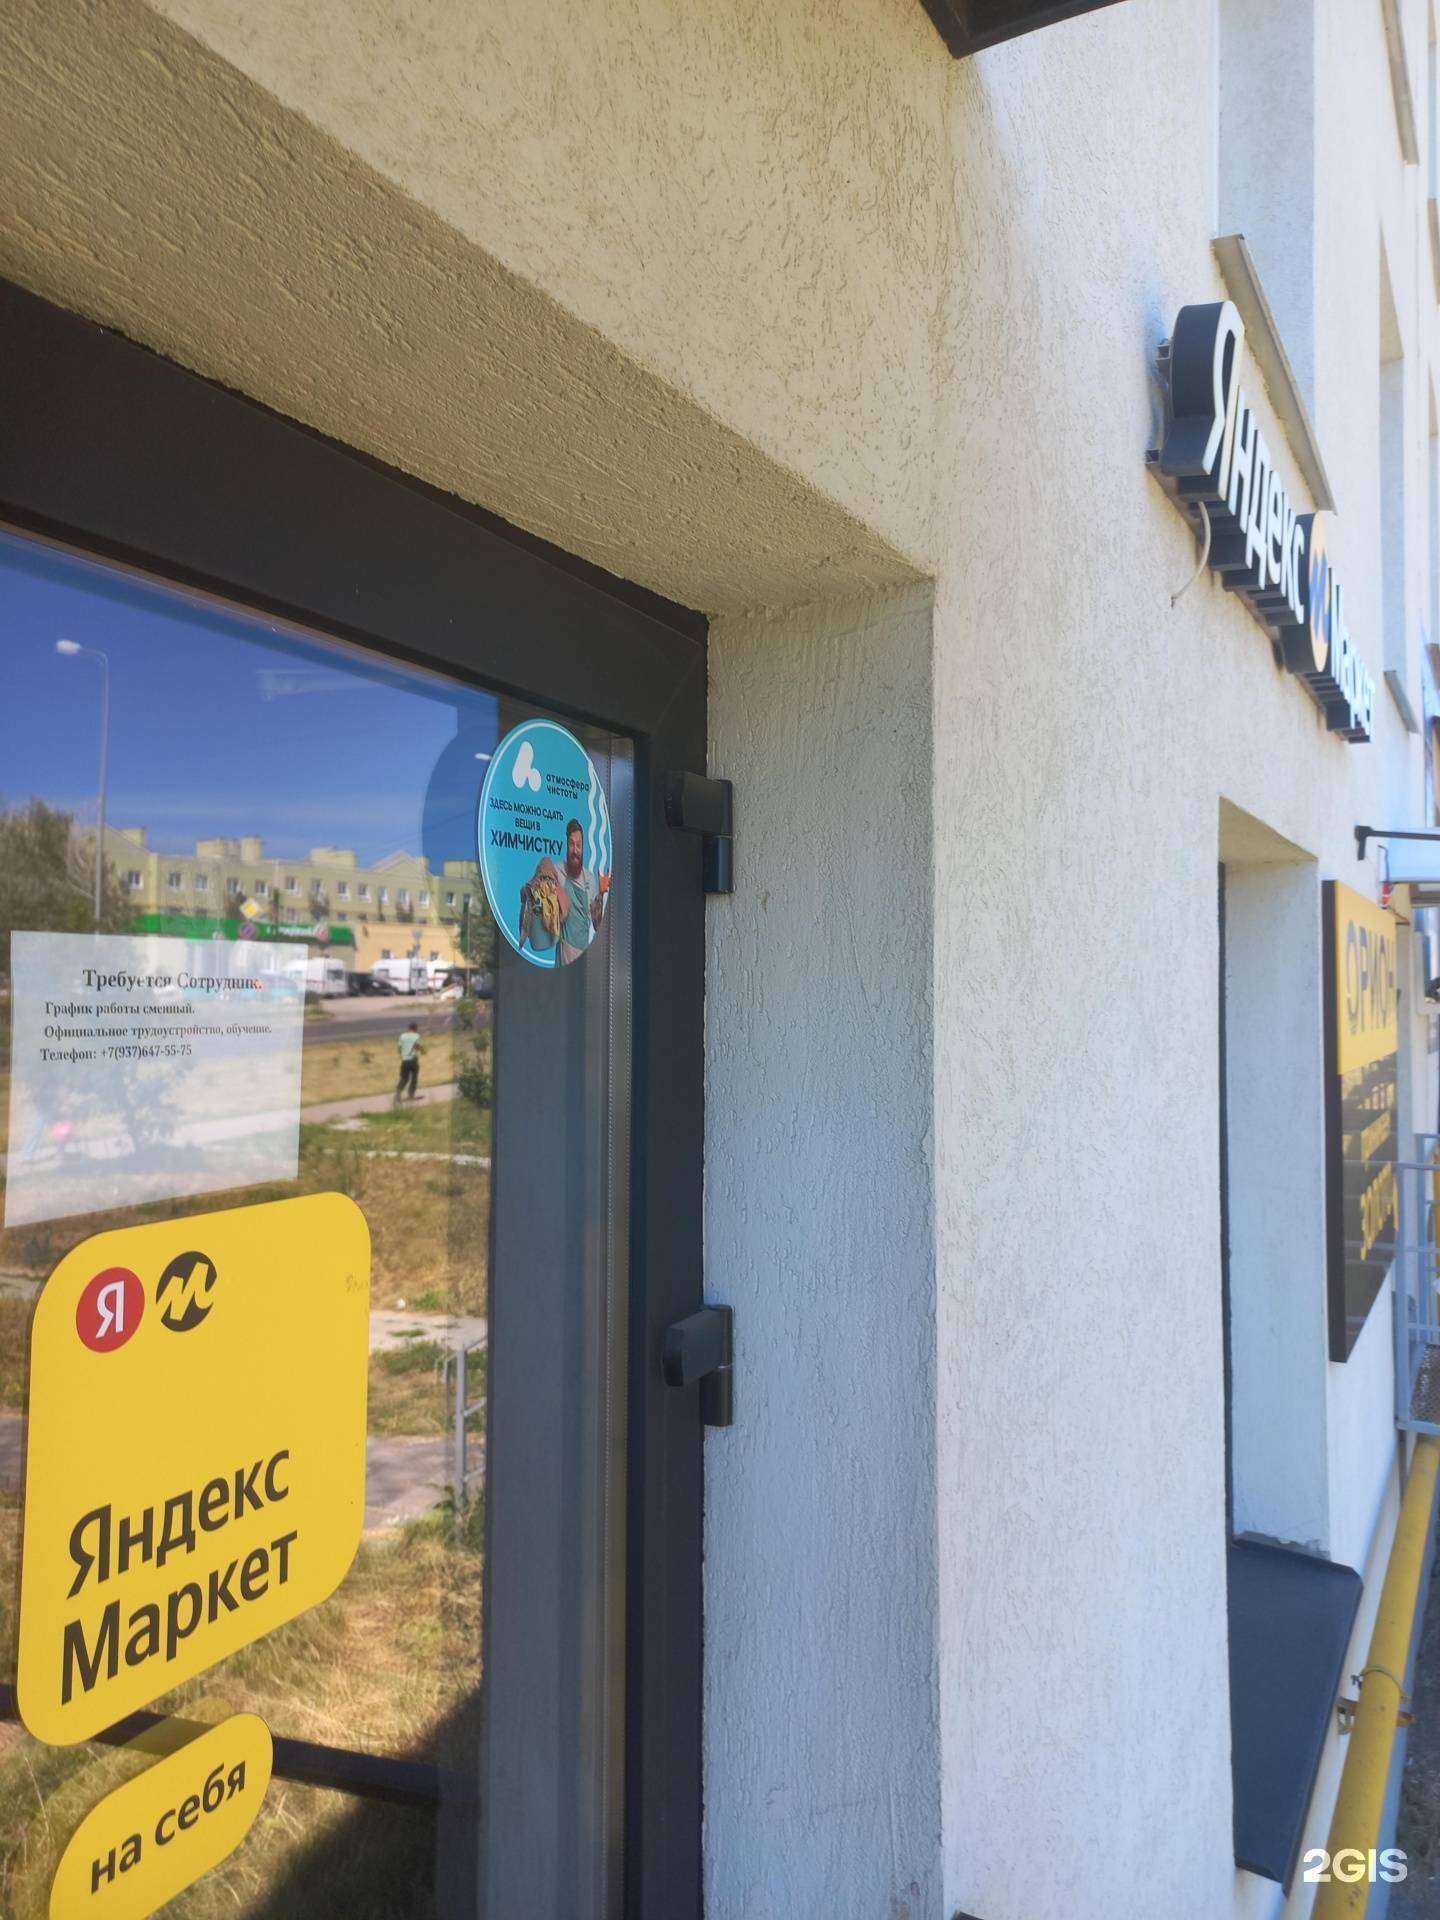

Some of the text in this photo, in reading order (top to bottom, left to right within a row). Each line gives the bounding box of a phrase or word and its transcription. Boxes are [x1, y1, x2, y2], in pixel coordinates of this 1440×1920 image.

[1202, 300, 1304, 625] Яндекс
[490, 798, 564, 821] ЗДЕСЬ МОЖНО СДАТЬ
[515, 818, 537, 830] ВЕЩИ
[491, 829, 564, 856] ХИМЧИСТКУ
[82, 969, 262, 993] Требуется Сотрудник.
[45, 1001, 93, 1018] График
[96, 1002, 140, 1017] работы
[44, 1025, 128, 1041] Официальное
[39, 1044, 192, 1063] Телефон: +7(937)647-55-75
[96, 1280, 125, 1339] Я
[66, 1450, 290, 1600] Яндекс
[61, 1530, 298, 1706] Маркет
[91, 1760, 246, 1895] на себя
